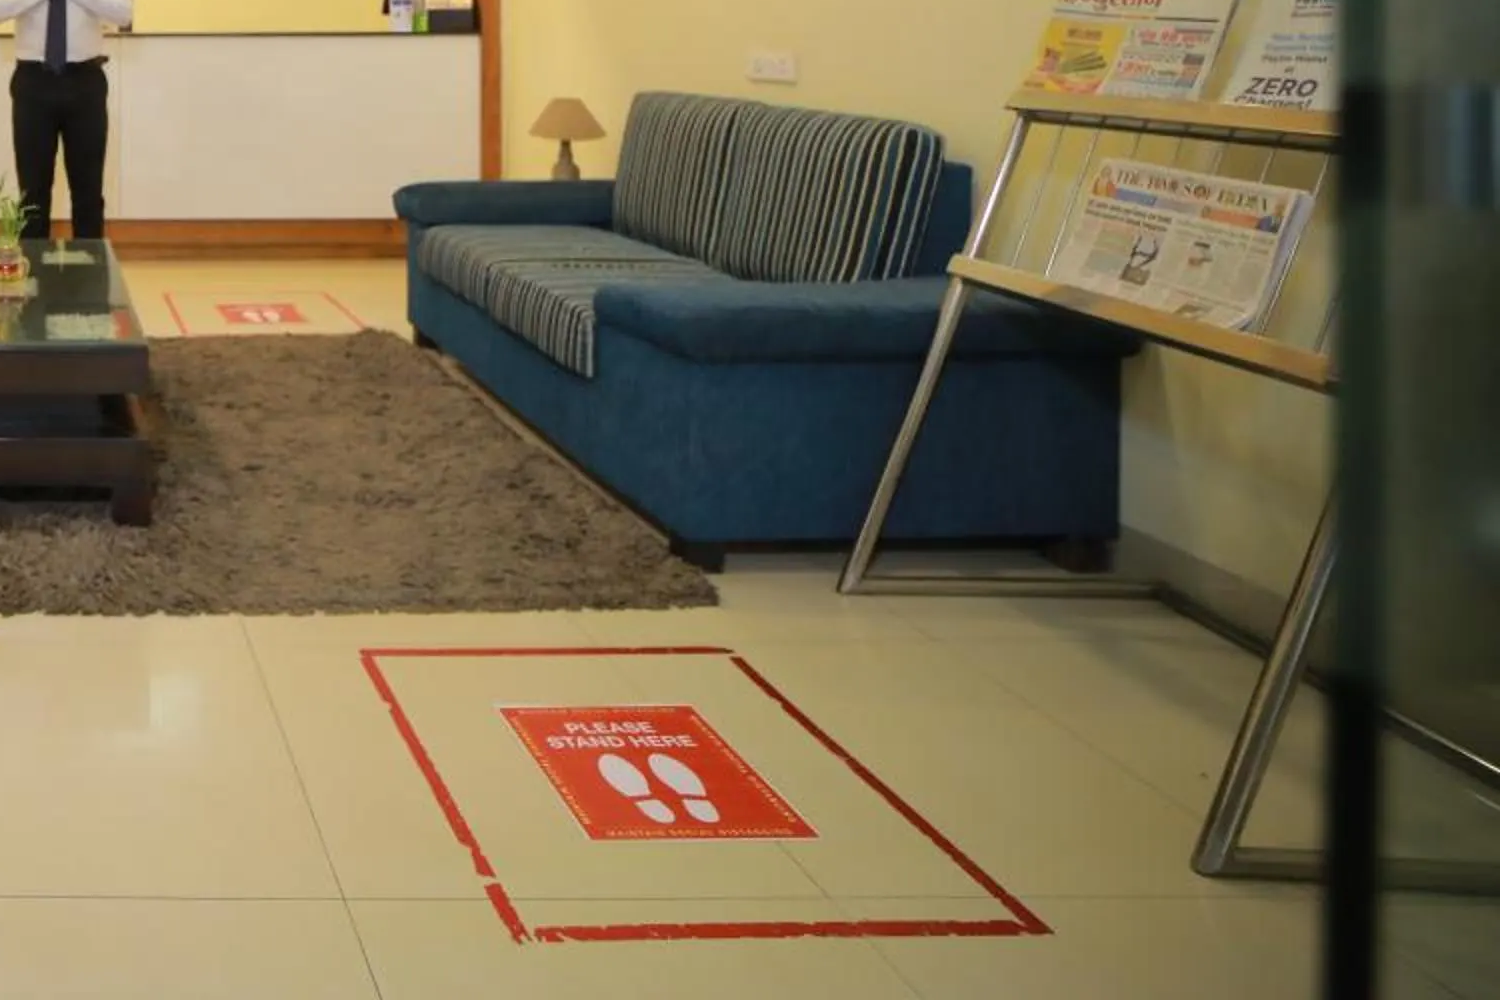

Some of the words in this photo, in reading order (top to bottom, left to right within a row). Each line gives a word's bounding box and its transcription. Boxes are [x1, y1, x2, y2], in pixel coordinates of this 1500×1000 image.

[1244, 76, 1319, 97] ZERO
[563, 720, 657, 735] PLEASE
[546, 735, 626, 749] STAND
[627, 734, 699, 748] HERE
